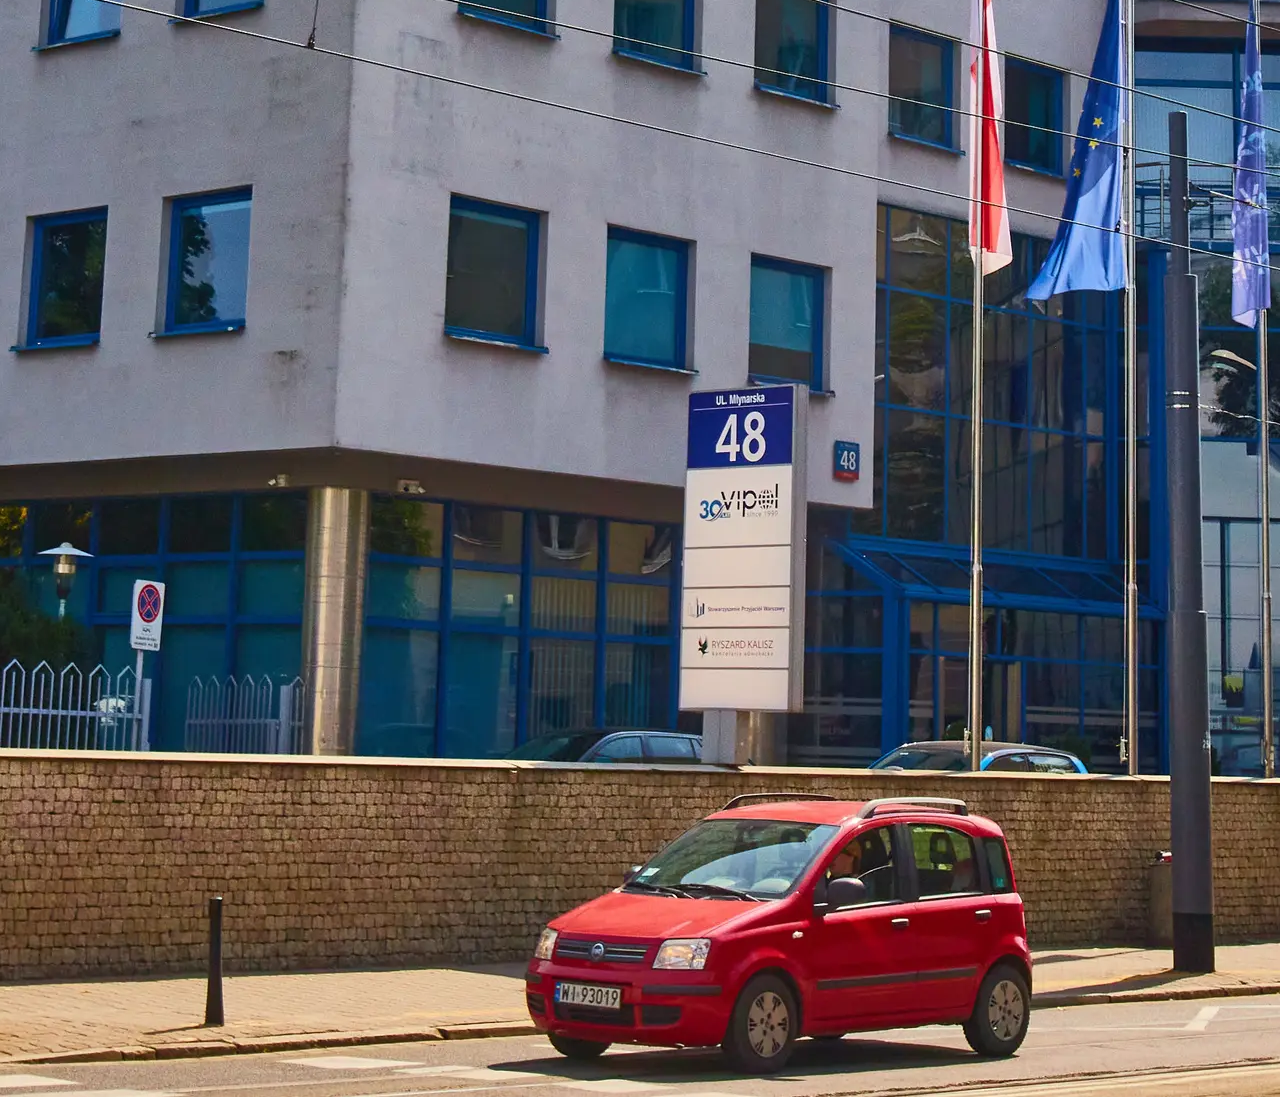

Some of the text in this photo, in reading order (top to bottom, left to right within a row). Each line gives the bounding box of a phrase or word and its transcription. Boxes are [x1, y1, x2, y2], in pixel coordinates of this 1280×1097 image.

[715, 393, 766, 406] UL. Młynarska
[715, 411, 766, 462] 48
[840, 450, 856, 470] 48
[711, 640, 774, 649] RYSZARD KALISZ
[581, 987, 619, 1006] 93019
